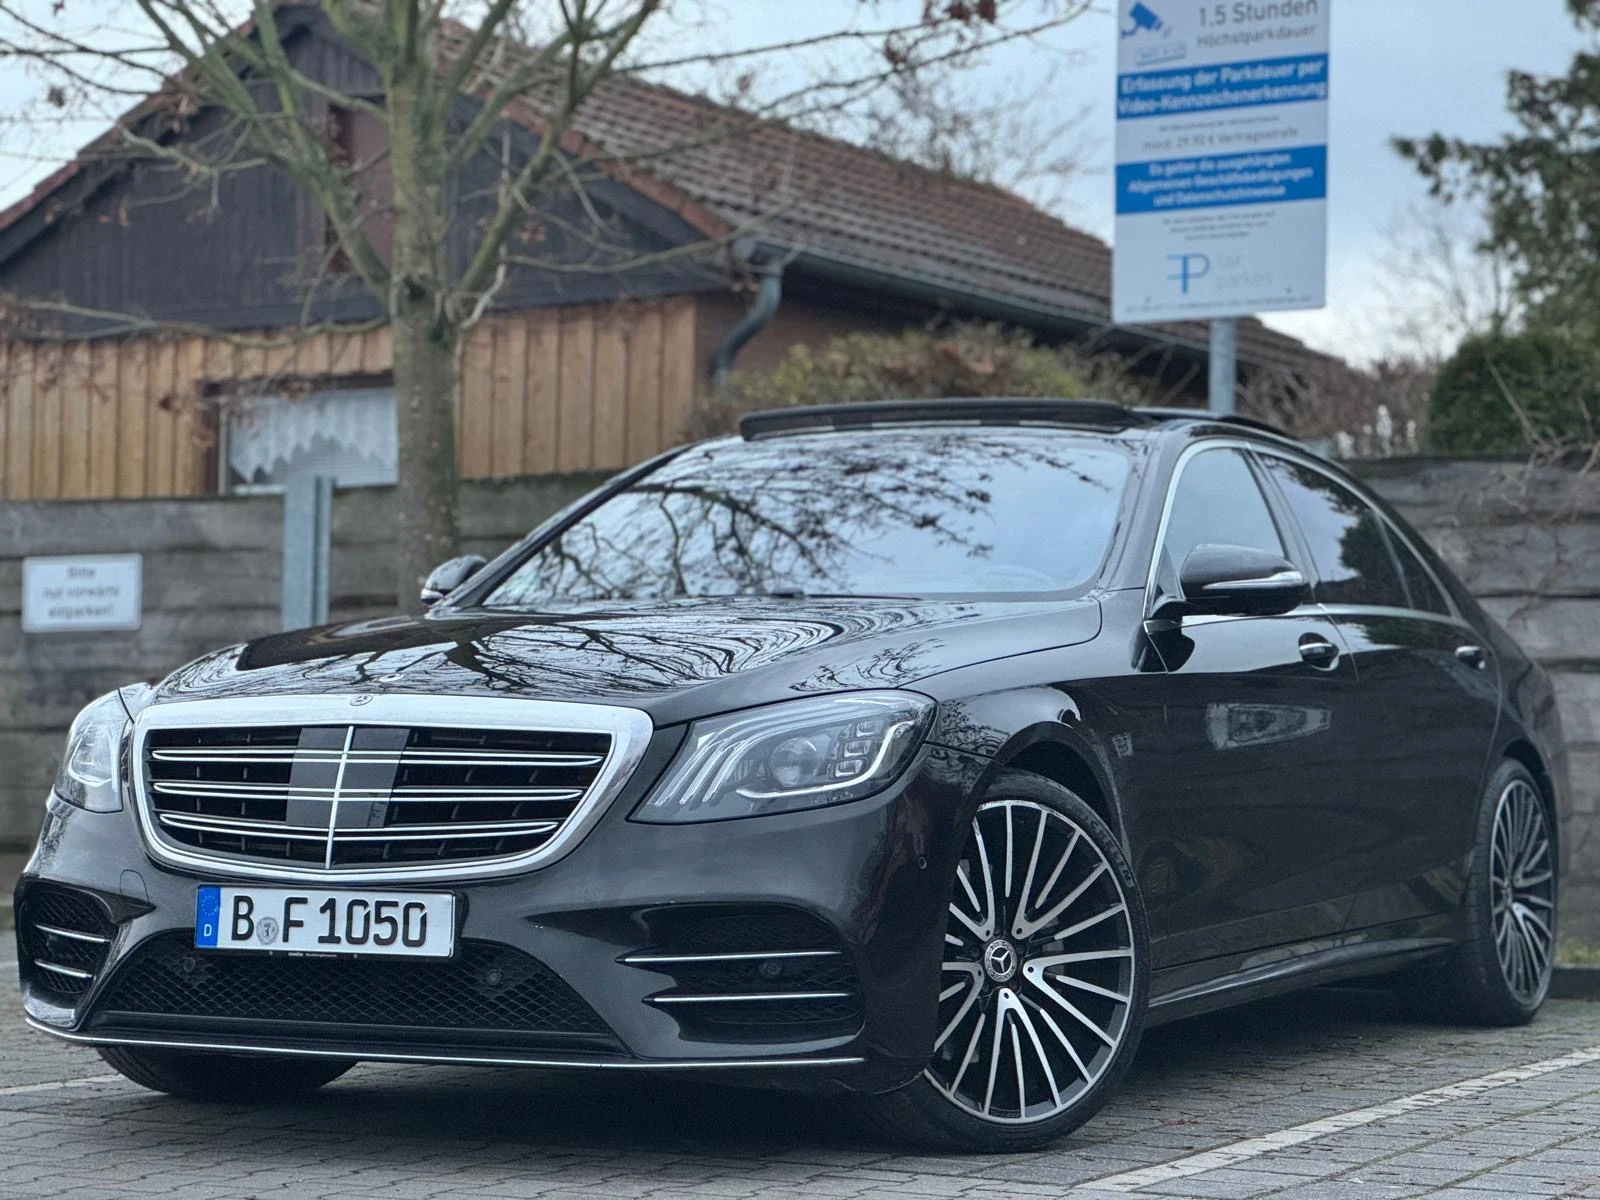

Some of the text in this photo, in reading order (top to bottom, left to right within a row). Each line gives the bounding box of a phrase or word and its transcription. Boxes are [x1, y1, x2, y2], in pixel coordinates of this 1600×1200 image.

[1232, 0, 1318, 24] Stunden
[1121, 60, 1324, 94] Erfassung der Parkdauer per
[203, 923, 212, 937] D
[231, 895, 428, 948] B F 1050
